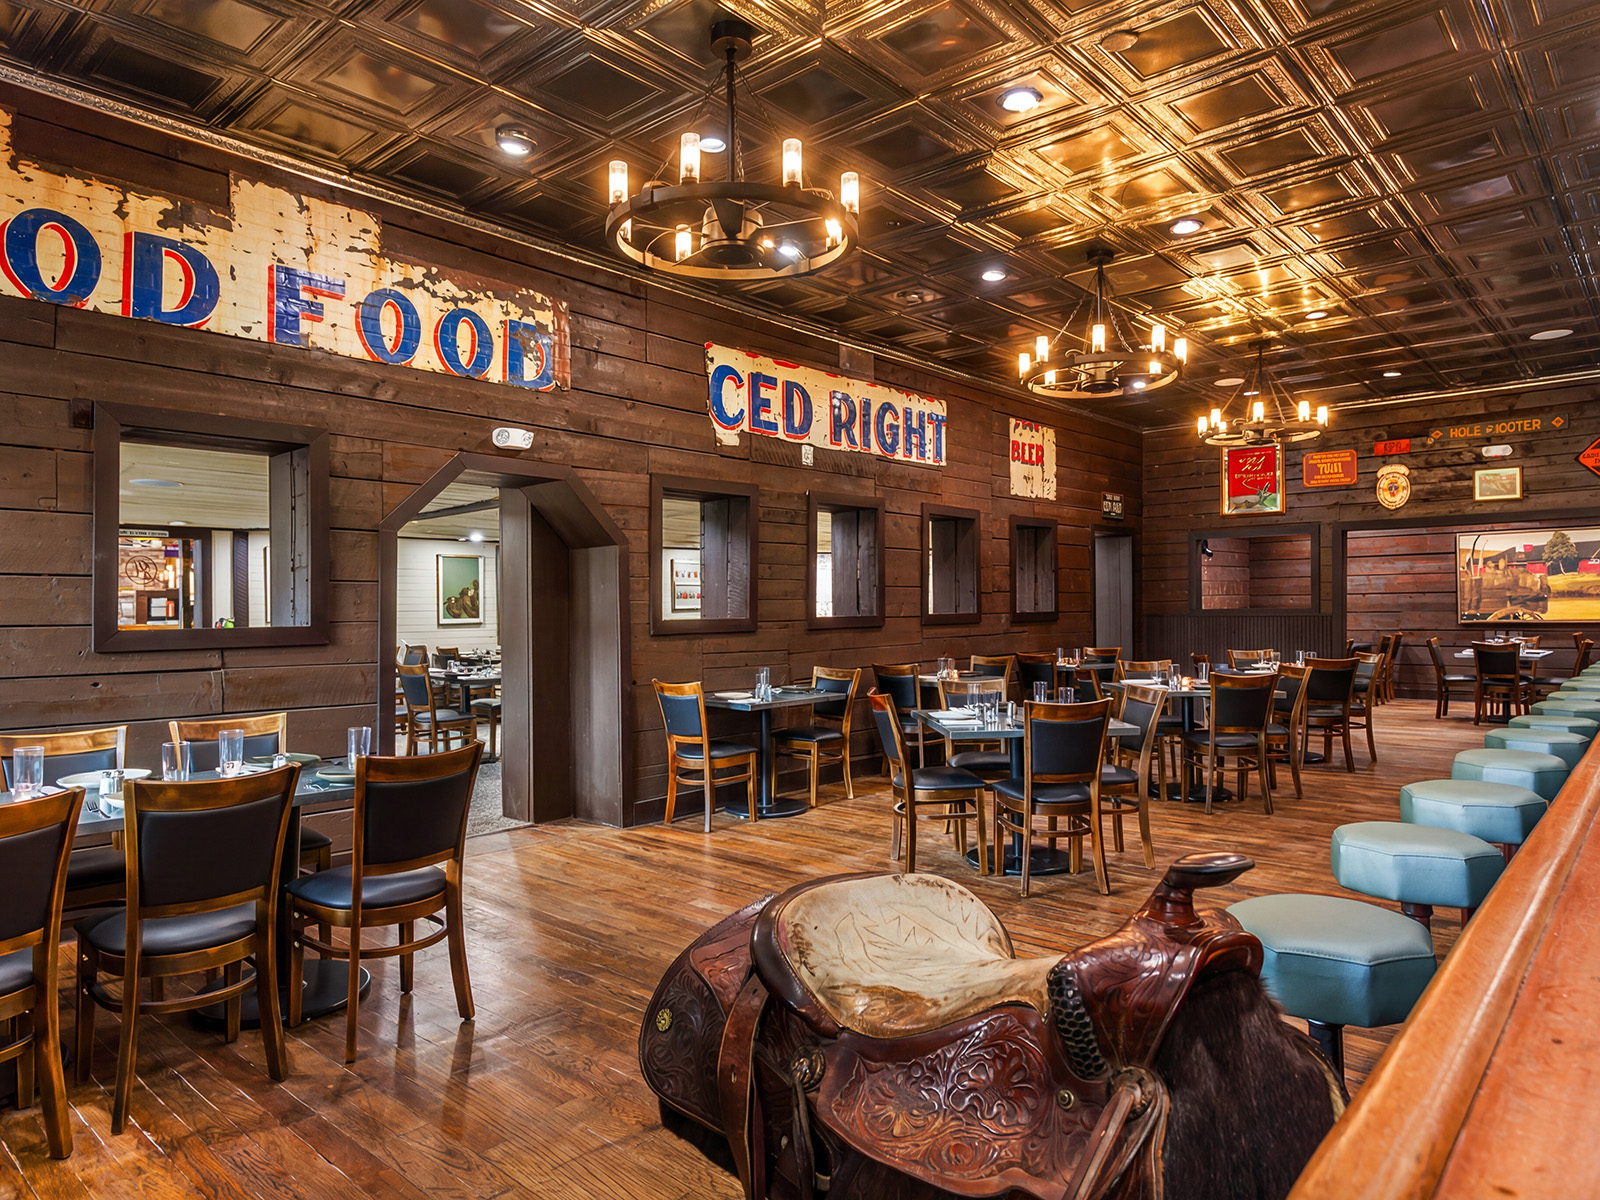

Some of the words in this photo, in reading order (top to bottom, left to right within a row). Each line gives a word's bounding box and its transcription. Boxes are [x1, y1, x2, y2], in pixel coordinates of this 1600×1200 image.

[267, 263, 556, 392] FOOD
[709, 364, 813, 440] CED
[829, 390, 947, 463] RIGHT
[1450, 425, 1482, 438] HOLE
[1011, 440, 1045, 469] BEER
